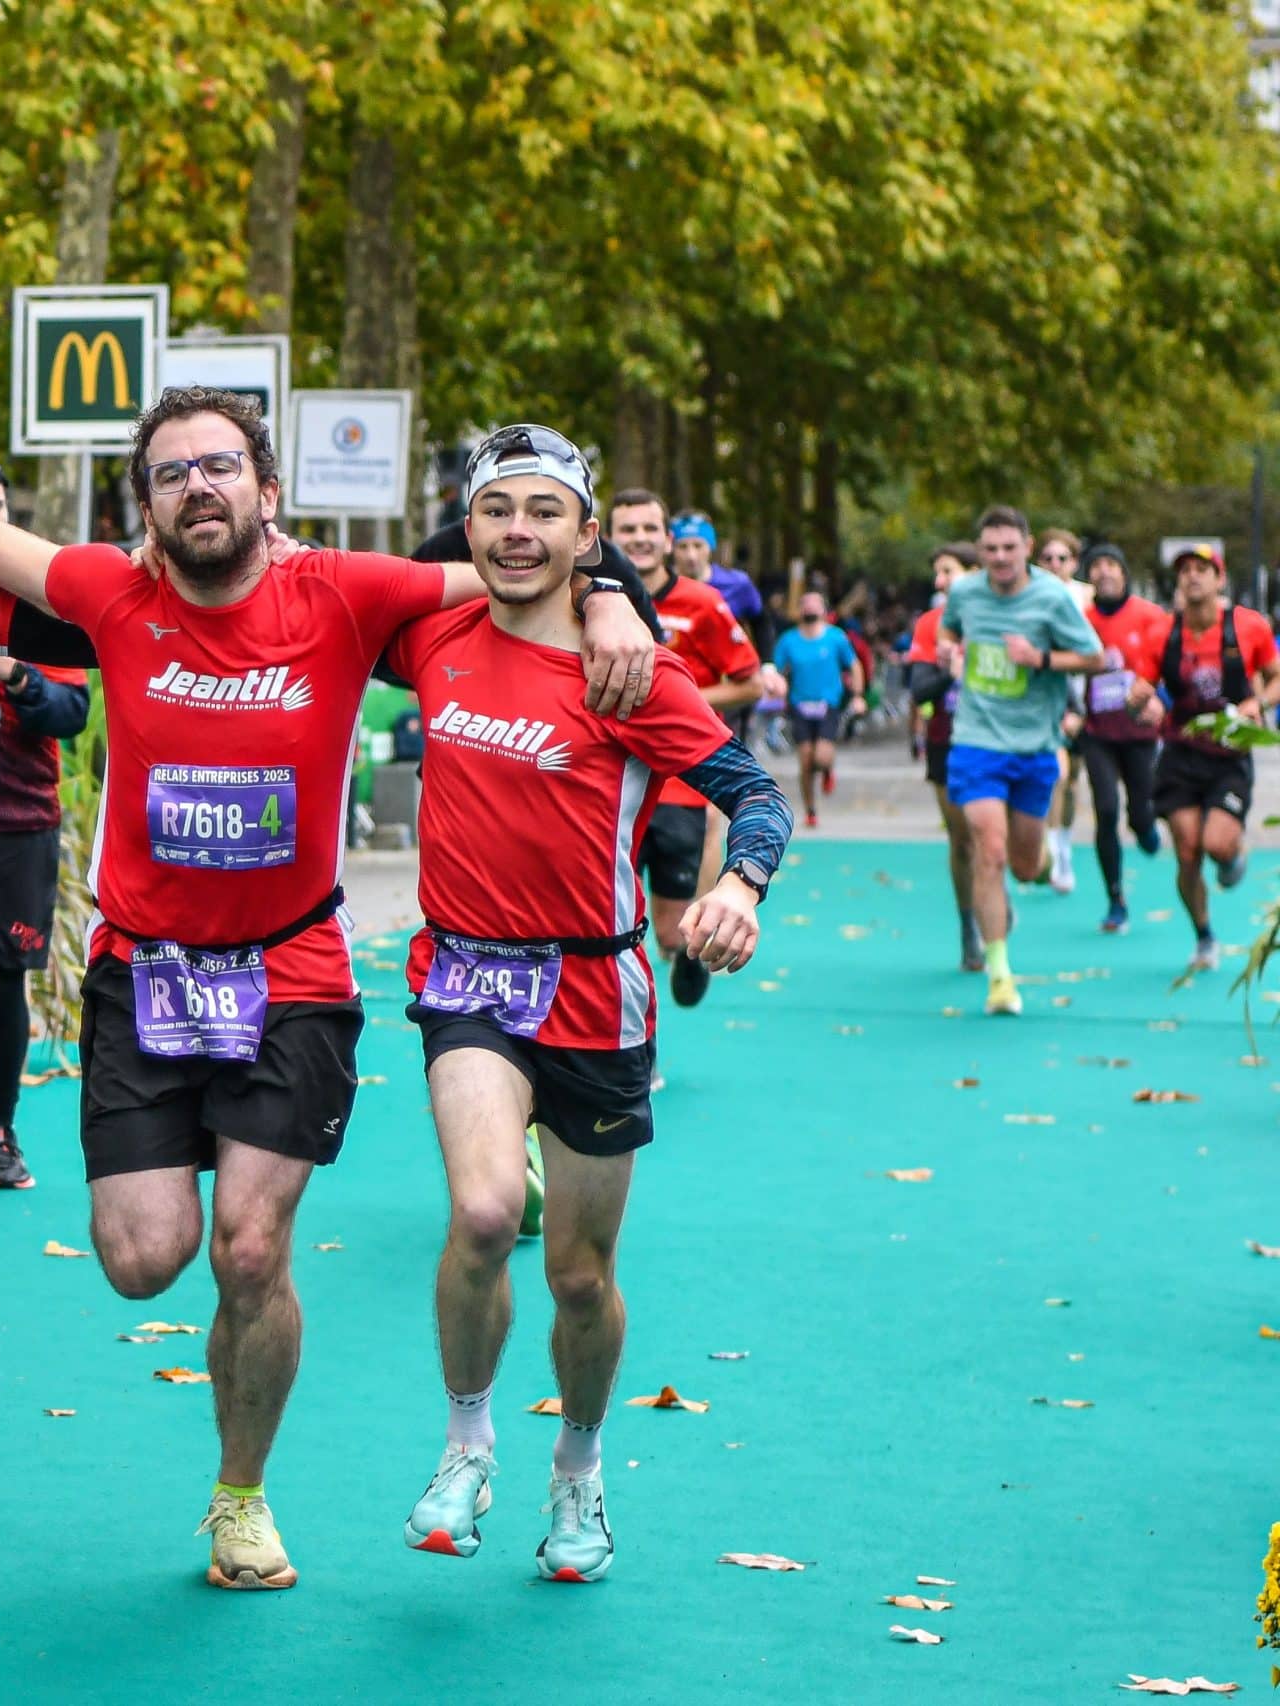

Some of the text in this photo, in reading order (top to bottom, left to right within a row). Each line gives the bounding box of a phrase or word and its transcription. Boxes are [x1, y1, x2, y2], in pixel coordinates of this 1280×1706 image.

[148, 661, 290, 701] Jeantil
[236, 702, 279, 711] transport
[429, 700, 556, 754] Jeantil
[154, 768, 291, 784] RELAIS ENTREPRISES 2025
[161, 794, 282, 840] R7618-4
